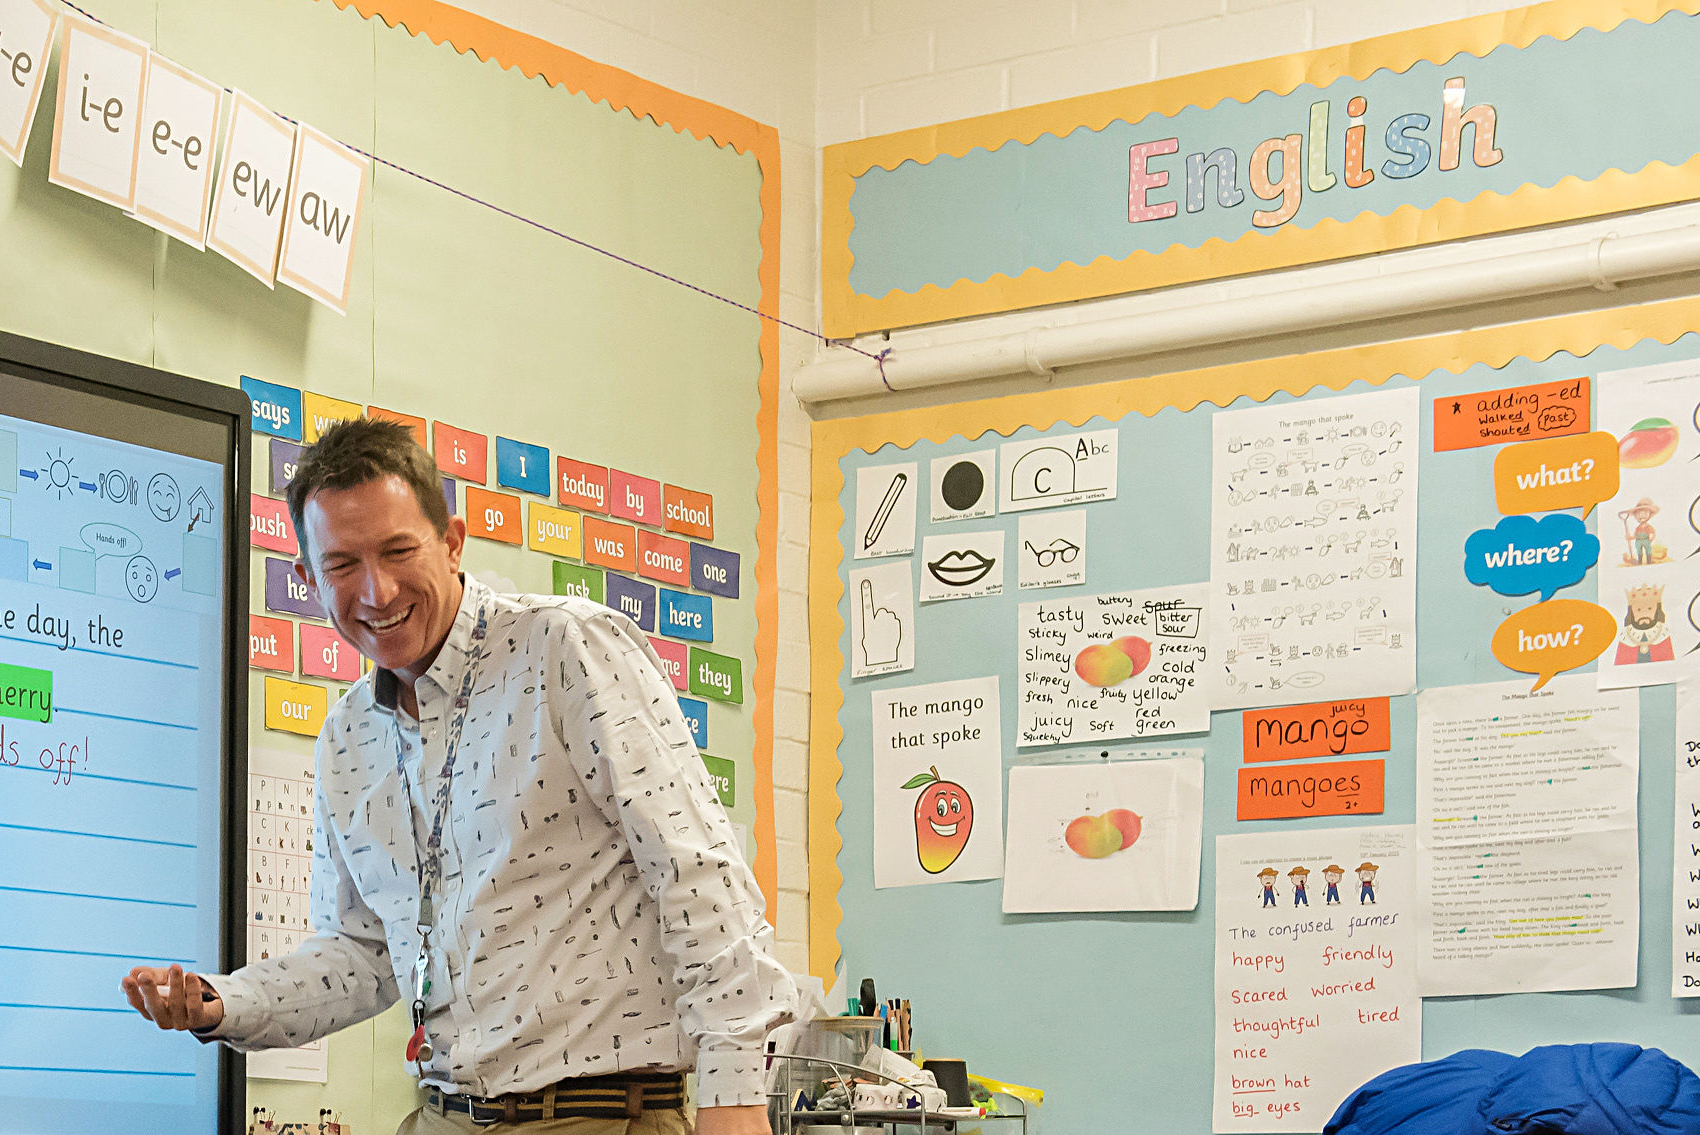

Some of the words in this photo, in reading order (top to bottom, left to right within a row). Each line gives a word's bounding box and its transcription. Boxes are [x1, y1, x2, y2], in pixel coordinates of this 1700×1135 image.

[80, 74, 123, 133] i-e
[150, 118, 203, 171] e-e
[1128, 76, 1503, 229] English
[231, 162, 281, 216] ew
[299, 194, 351, 246] aw
[1477, 392, 1539, 413] adding
[1547, 381, 1582, 400] -ed
[252, 398, 290, 430] says
[1479, 423, 1530, 437] shouted
[453, 441, 467, 466] is
[519, 456, 527, 479] I
[1516, 458, 1595, 490] what?
[563, 472, 604, 507] today
[626, 486, 644, 516] by
[484, 508, 504, 534] go
[666, 501, 710, 528] school
[537, 519, 573, 543] your
[594, 538, 625, 558] was
[644, 549, 683, 573] come
[1484, 540, 1574, 567] where?
[703, 562, 727, 584] one
[620, 596, 642, 624] my
[669, 601, 702, 628] here
[1037, 605, 1084, 632] tasty
[27, 603, 77, 651] day,
[88, 613, 124, 651] the
[1517, 625, 1584, 652] how?
[322, 642, 339, 672] of
[1159, 643, 1206, 662] freezing
[698, 660, 732, 695] they
[1162, 661, 1195, 673] cold
[1132, 686, 1178, 706] yellow
[1148, 674, 1195, 693] orange
[280, 701, 312, 720] our
[888, 700, 923, 719] The
[926, 696, 985, 719] mango
[1067, 696, 1099, 710] nice
[1135, 706, 1161, 718] red
[1329, 702, 1366, 718] juicy
[891, 727, 925, 748] that
[931, 725, 982, 750] spoke
[1031, 712, 1073, 737] juicy
[1136, 718, 1175, 734] green
[1255, 717, 1369, 754] mango
[39, 734, 91, 786] off!
[1249, 775, 1361, 808] mangoes
[1228, 927, 1256, 940] The
[1268, 918, 1333, 940] confused
[1348, 913, 1399, 937] farmer
[1233, 952, 1285, 973] happy
[1322, 945, 1393, 968] friendly
[1233, 1015, 1320, 1039] thoughtful
[1358, 1006, 1400, 1023] tired
[1233, 1044, 1267, 1058] nice
[1232, 1075, 1276, 1093] brown
[1285, 1074, 1310, 1088] hat
[1233, 1102, 1254, 1117] big
[1267, 1102, 1301, 1119] eyes
